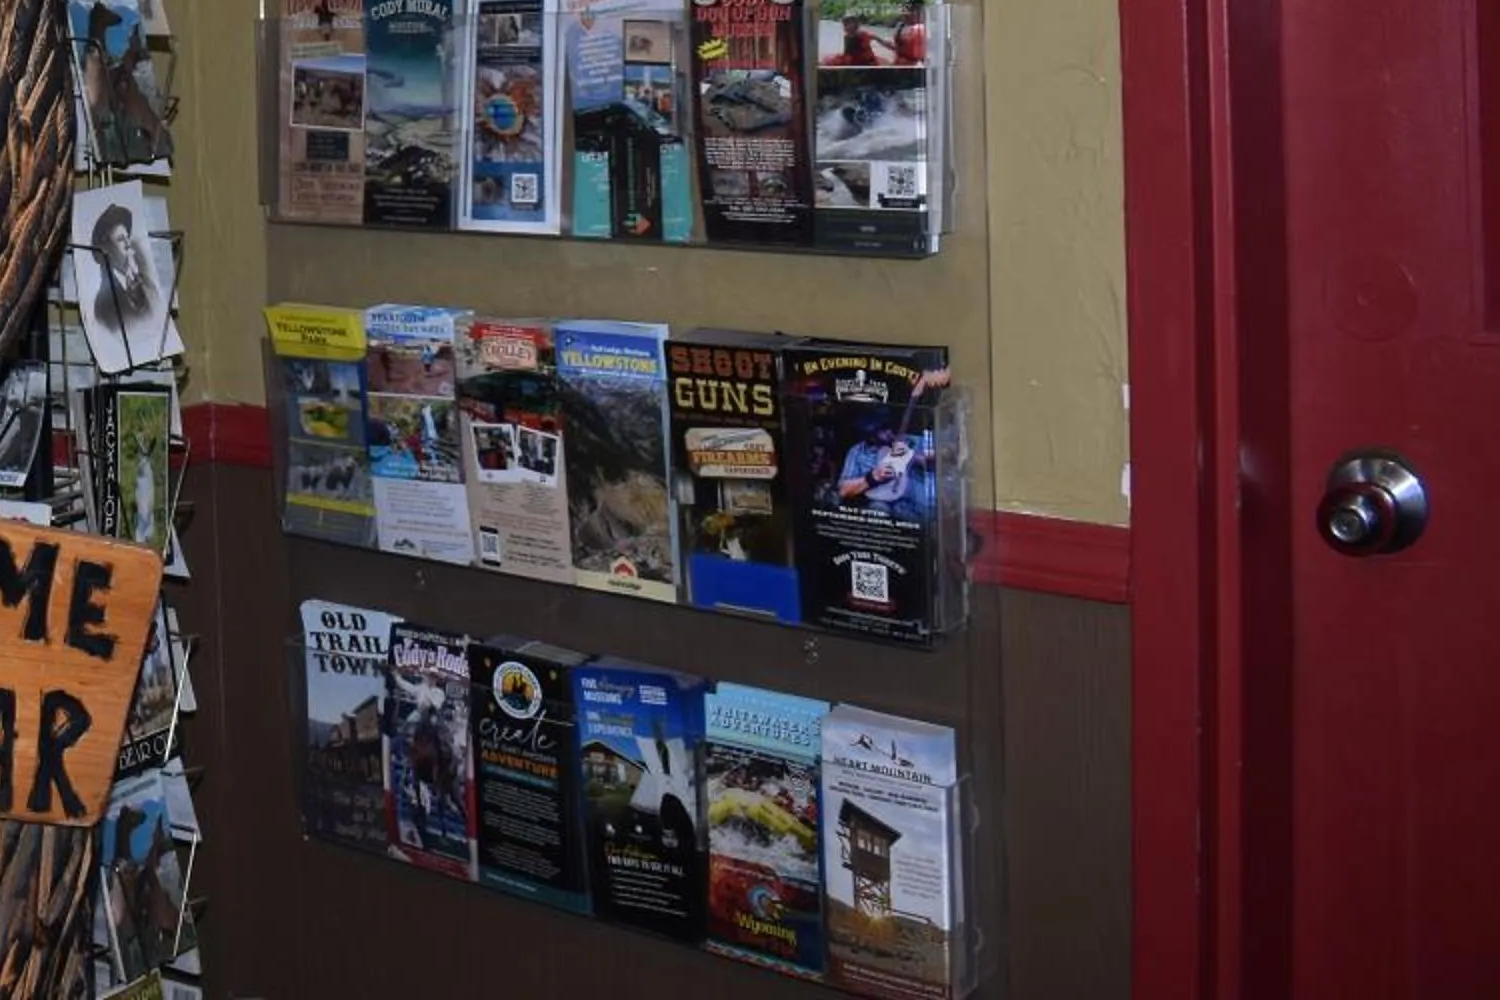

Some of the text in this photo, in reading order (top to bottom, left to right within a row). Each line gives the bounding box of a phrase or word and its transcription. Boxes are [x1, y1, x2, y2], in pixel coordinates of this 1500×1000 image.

[670, 345, 772, 380] SHOOT
[674, 376, 775, 417] GUNS
[103, 397, 118, 537] JACKALOP
[320, 610, 367, 631] OLD
[309, 631, 389, 654] TRAIL
